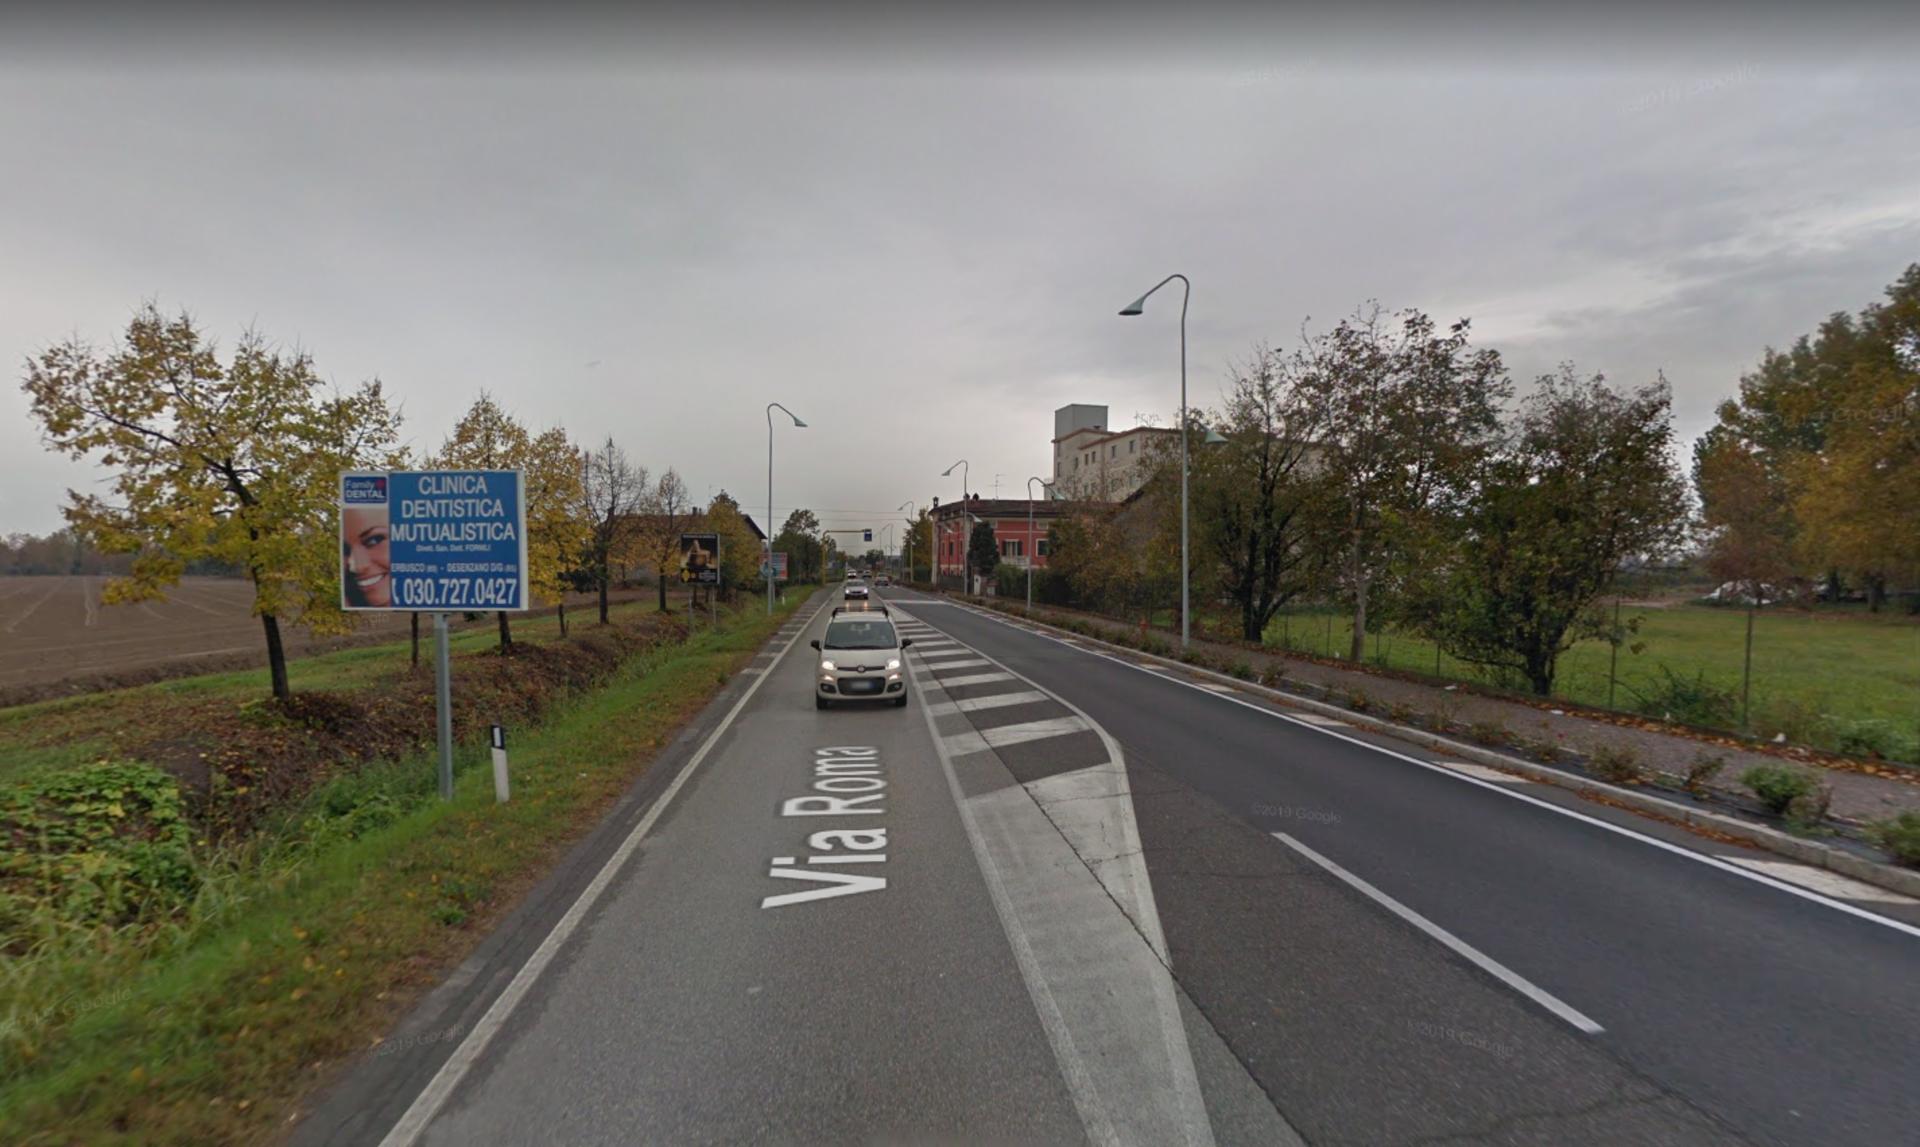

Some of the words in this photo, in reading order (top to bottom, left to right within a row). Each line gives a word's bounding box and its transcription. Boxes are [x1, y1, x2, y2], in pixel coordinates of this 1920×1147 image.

[345, 490, 385, 499] DENTAL
[418, 476, 488, 495] CLINICA
[401, 499, 504, 518] DENTISTICA
[390, 523, 516, 542] MUTUALISTICA
[403, 578, 517, 605] 030.727.0427
